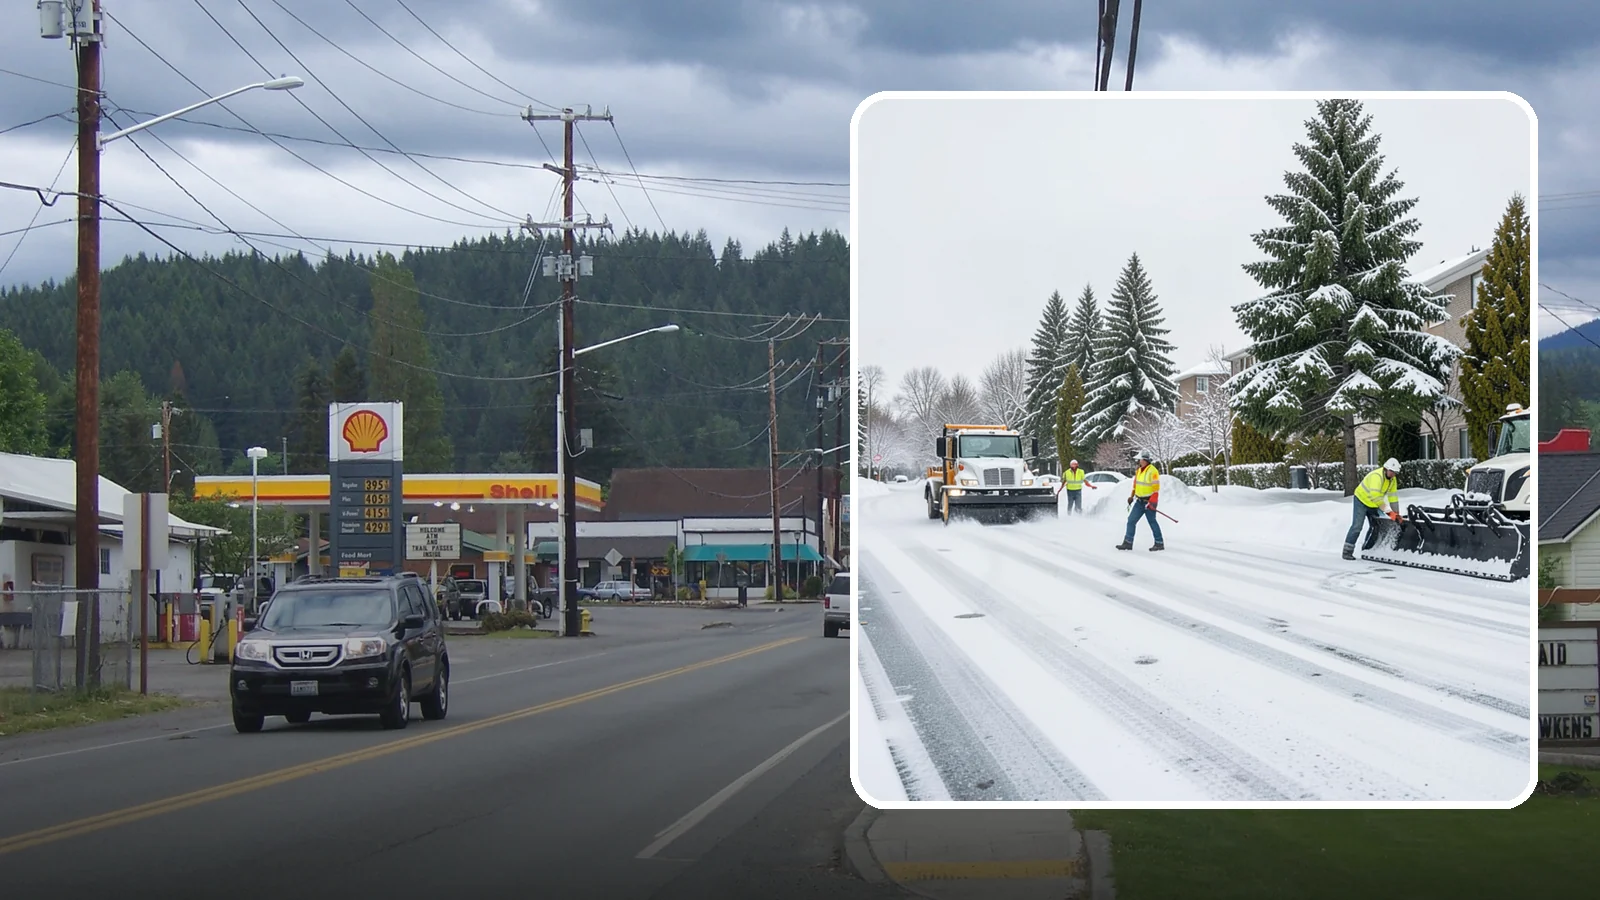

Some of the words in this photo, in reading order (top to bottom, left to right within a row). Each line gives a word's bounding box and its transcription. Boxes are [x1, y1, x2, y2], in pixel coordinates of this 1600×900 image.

[365, 480, 384, 490] 395
[490, 484, 547, 498] Shell
[365, 494, 384, 504] 405
[365, 508, 384, 518] 415
[365, 522, 384, 532] 429
